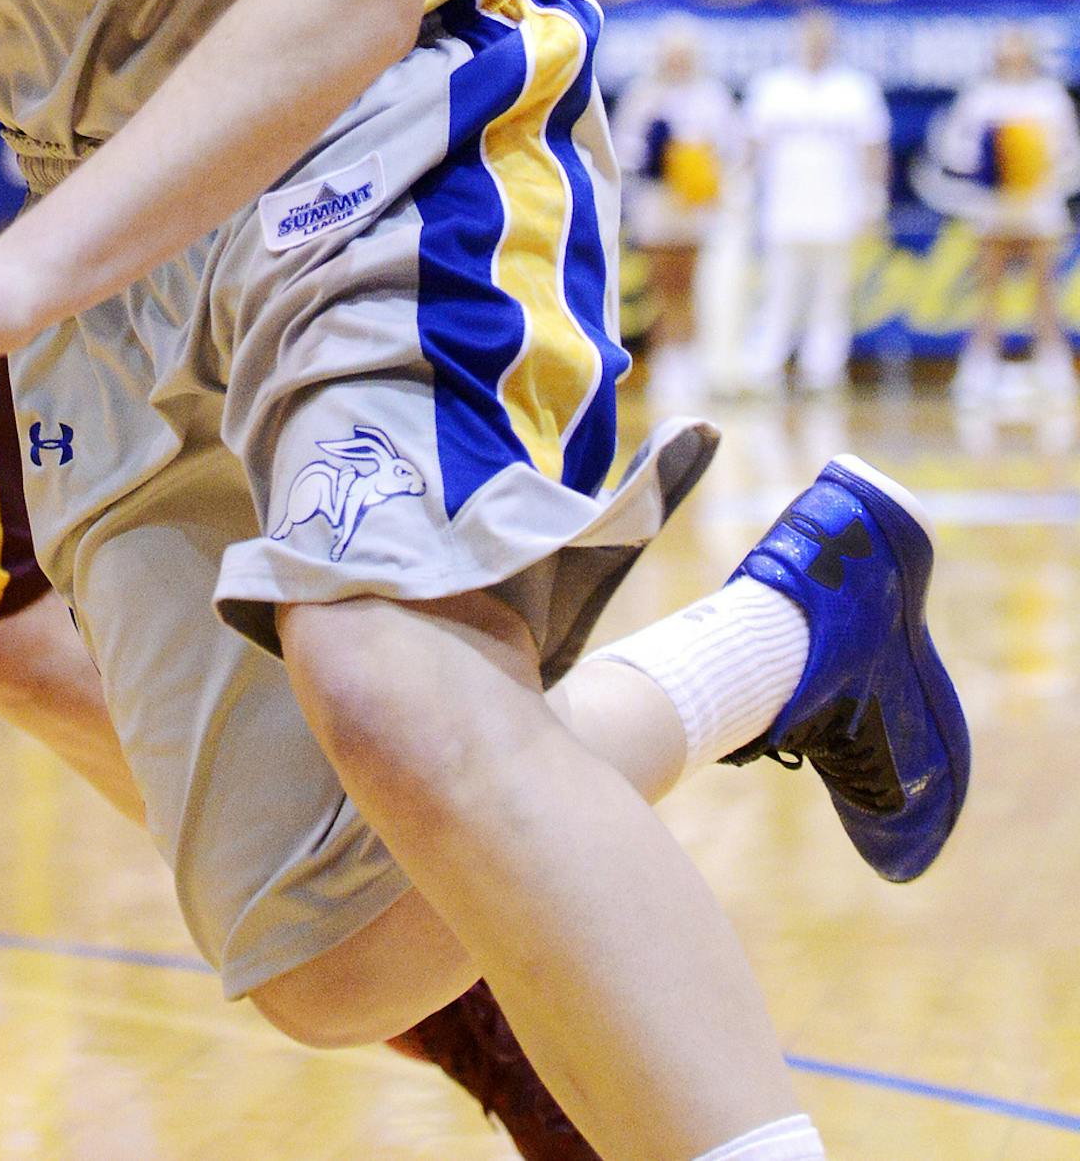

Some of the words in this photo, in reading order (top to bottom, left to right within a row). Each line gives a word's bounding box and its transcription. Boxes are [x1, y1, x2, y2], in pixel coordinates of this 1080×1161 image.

[277, 181, 374, 238] SUMMIT
[289, 202, 311, 215] THE
[303, 208, 355, 236] LEAGUE
